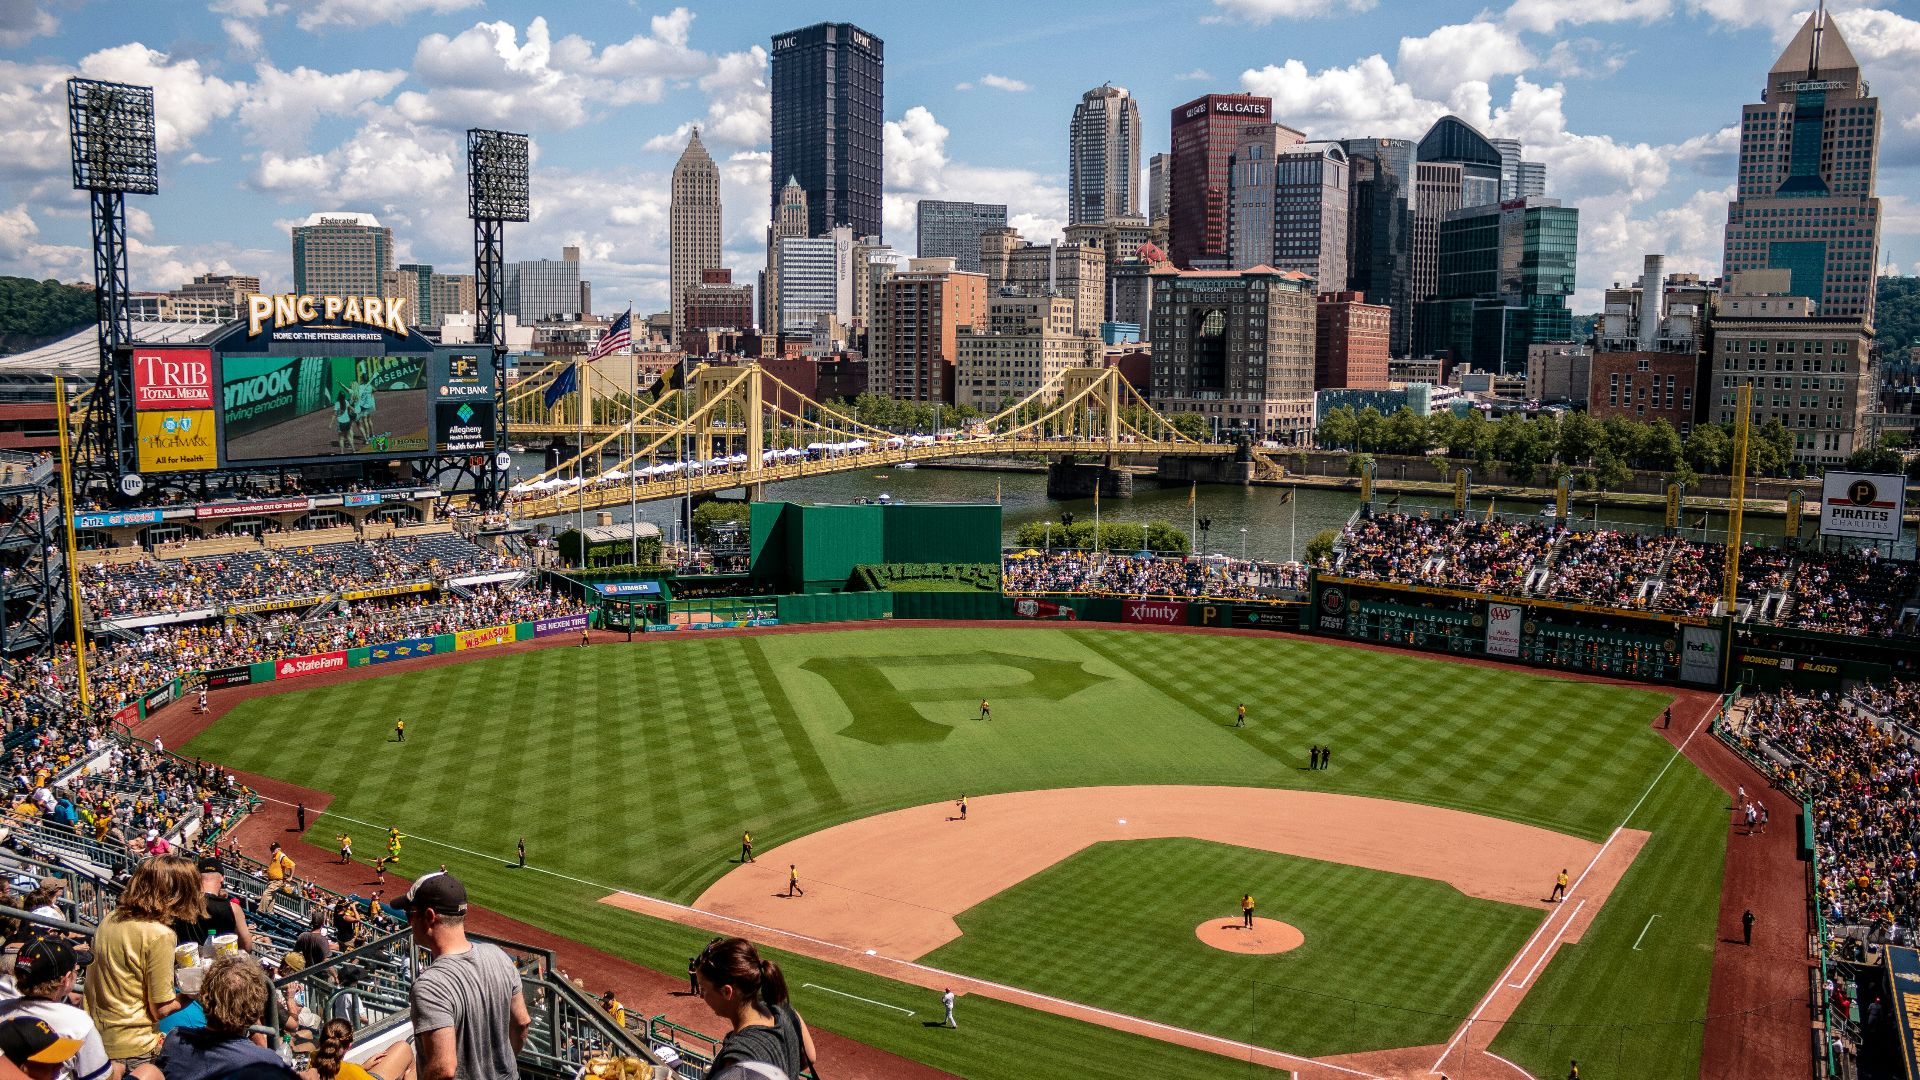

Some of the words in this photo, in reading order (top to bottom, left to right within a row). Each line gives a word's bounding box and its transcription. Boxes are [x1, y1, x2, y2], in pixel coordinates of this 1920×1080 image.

[773, 36, 797, 51] UPMC
[853, 31, 871, 49] UPMC
[1216, 102, 1233, 112] K&L
[1235, 103, 1266, 114] GATES
[1390, 140, 1405, 148] PNC
[320, 216, 358, 225] Federated
[247, 293, 318, 337] PNC
[323, 295, 409, 337] PARK
[138, 356, 207, 386] TRIB
[374, 363, 421, 387] BASEBALL
[140, 387, 176, 399] TOTAL
[176, 388, 209, 399] MEDIA
[449, 386, 467, 395] PNC
[467, 386, 488, 394] BANK
[255, 394, 293, 413] emotion
[449, 426, 482, 434] Allegheny
[150, 436, 208, 449] HIGHMARK
[447, 442, 466, 451] Health
[466, 442, 475, 450] for
[475, 441, 485, 449] All
[156, 456, 168, 465] All
[168, 456, 178, 464] for
[180, 455, 204, 463] Health
[497, 456, 510, 465] Lite
[124, 478, 141, 490] Lite
[1856, 485, 1869, 501] P
[1832, 508, 1889, 521] PIRATES
[1831, 519, 1888, 530] CHARITIES
[372, 588, 395, 597] LIGHT
[619, 584, 649, 592] LUMBER
[270, 601, 290, 609] CITY
[293, 598, 317, 606] BEER
[1131, 605, 1179, 622] xfinity
[1203, 606, 1217, 625] P
[1362, 607, 1419, 620] NATIONAL
[1424, 614, 1469, 626] LEAGUE
[1491, 606, 1510, 620] AAA
[548, 620, 570, 630] NEXEN
[571, 617, 586, 626] TIRE
[1319, 620, 1343, 630] FAST!
[1489, 635, 1519, 644] Insurance
[1538, 629, 1605, 644] AMERICAN
[1610, 637, 1662, 651] LEAGUE
[1489, 646, 1517, 655] AAA.com
[1687, 641, 1715, 653] FedEx
[1743, 655, 1779, 666] BOWSER
[1802, 662, 1838, 673] BLASTS
[227, 675, 250, 683] SPORTS
